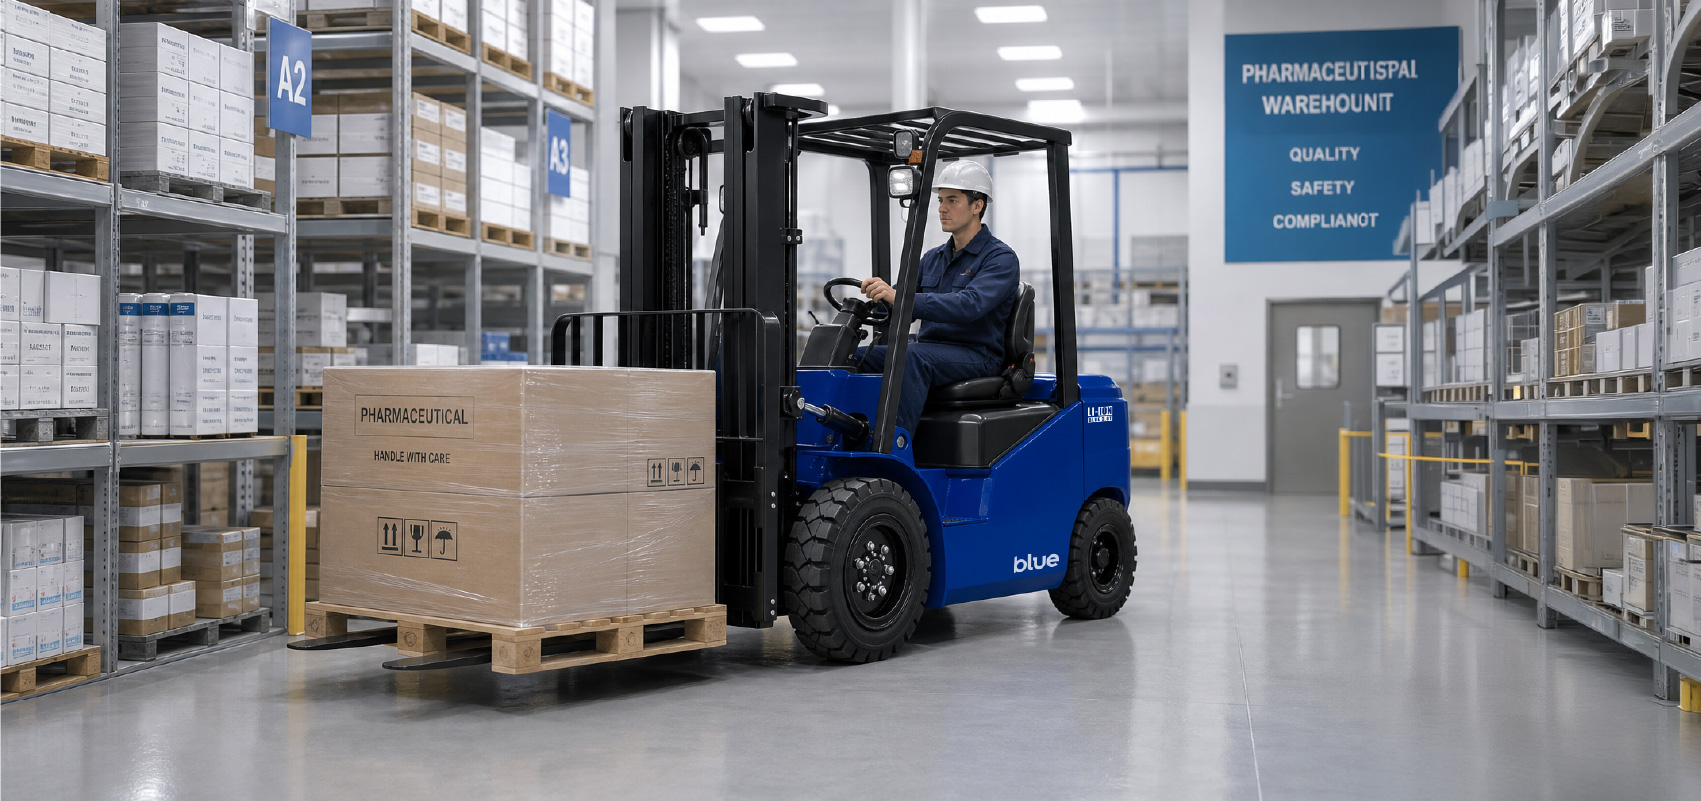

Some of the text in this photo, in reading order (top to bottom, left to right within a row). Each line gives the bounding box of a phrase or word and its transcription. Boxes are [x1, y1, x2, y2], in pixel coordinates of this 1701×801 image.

[277, 55, 307, 107] A2
[550, 136, 569, 175] A3
[1289, 146, 1361, 163] QUALITY
[1290, 180, 1355, 196] SAFETY
[361, 407, 468, 425] PHARMACEUTICAL
[374, 450, 451, 464] HANDLE WITH CARE
[1013, 553, 1060, 574] blue
